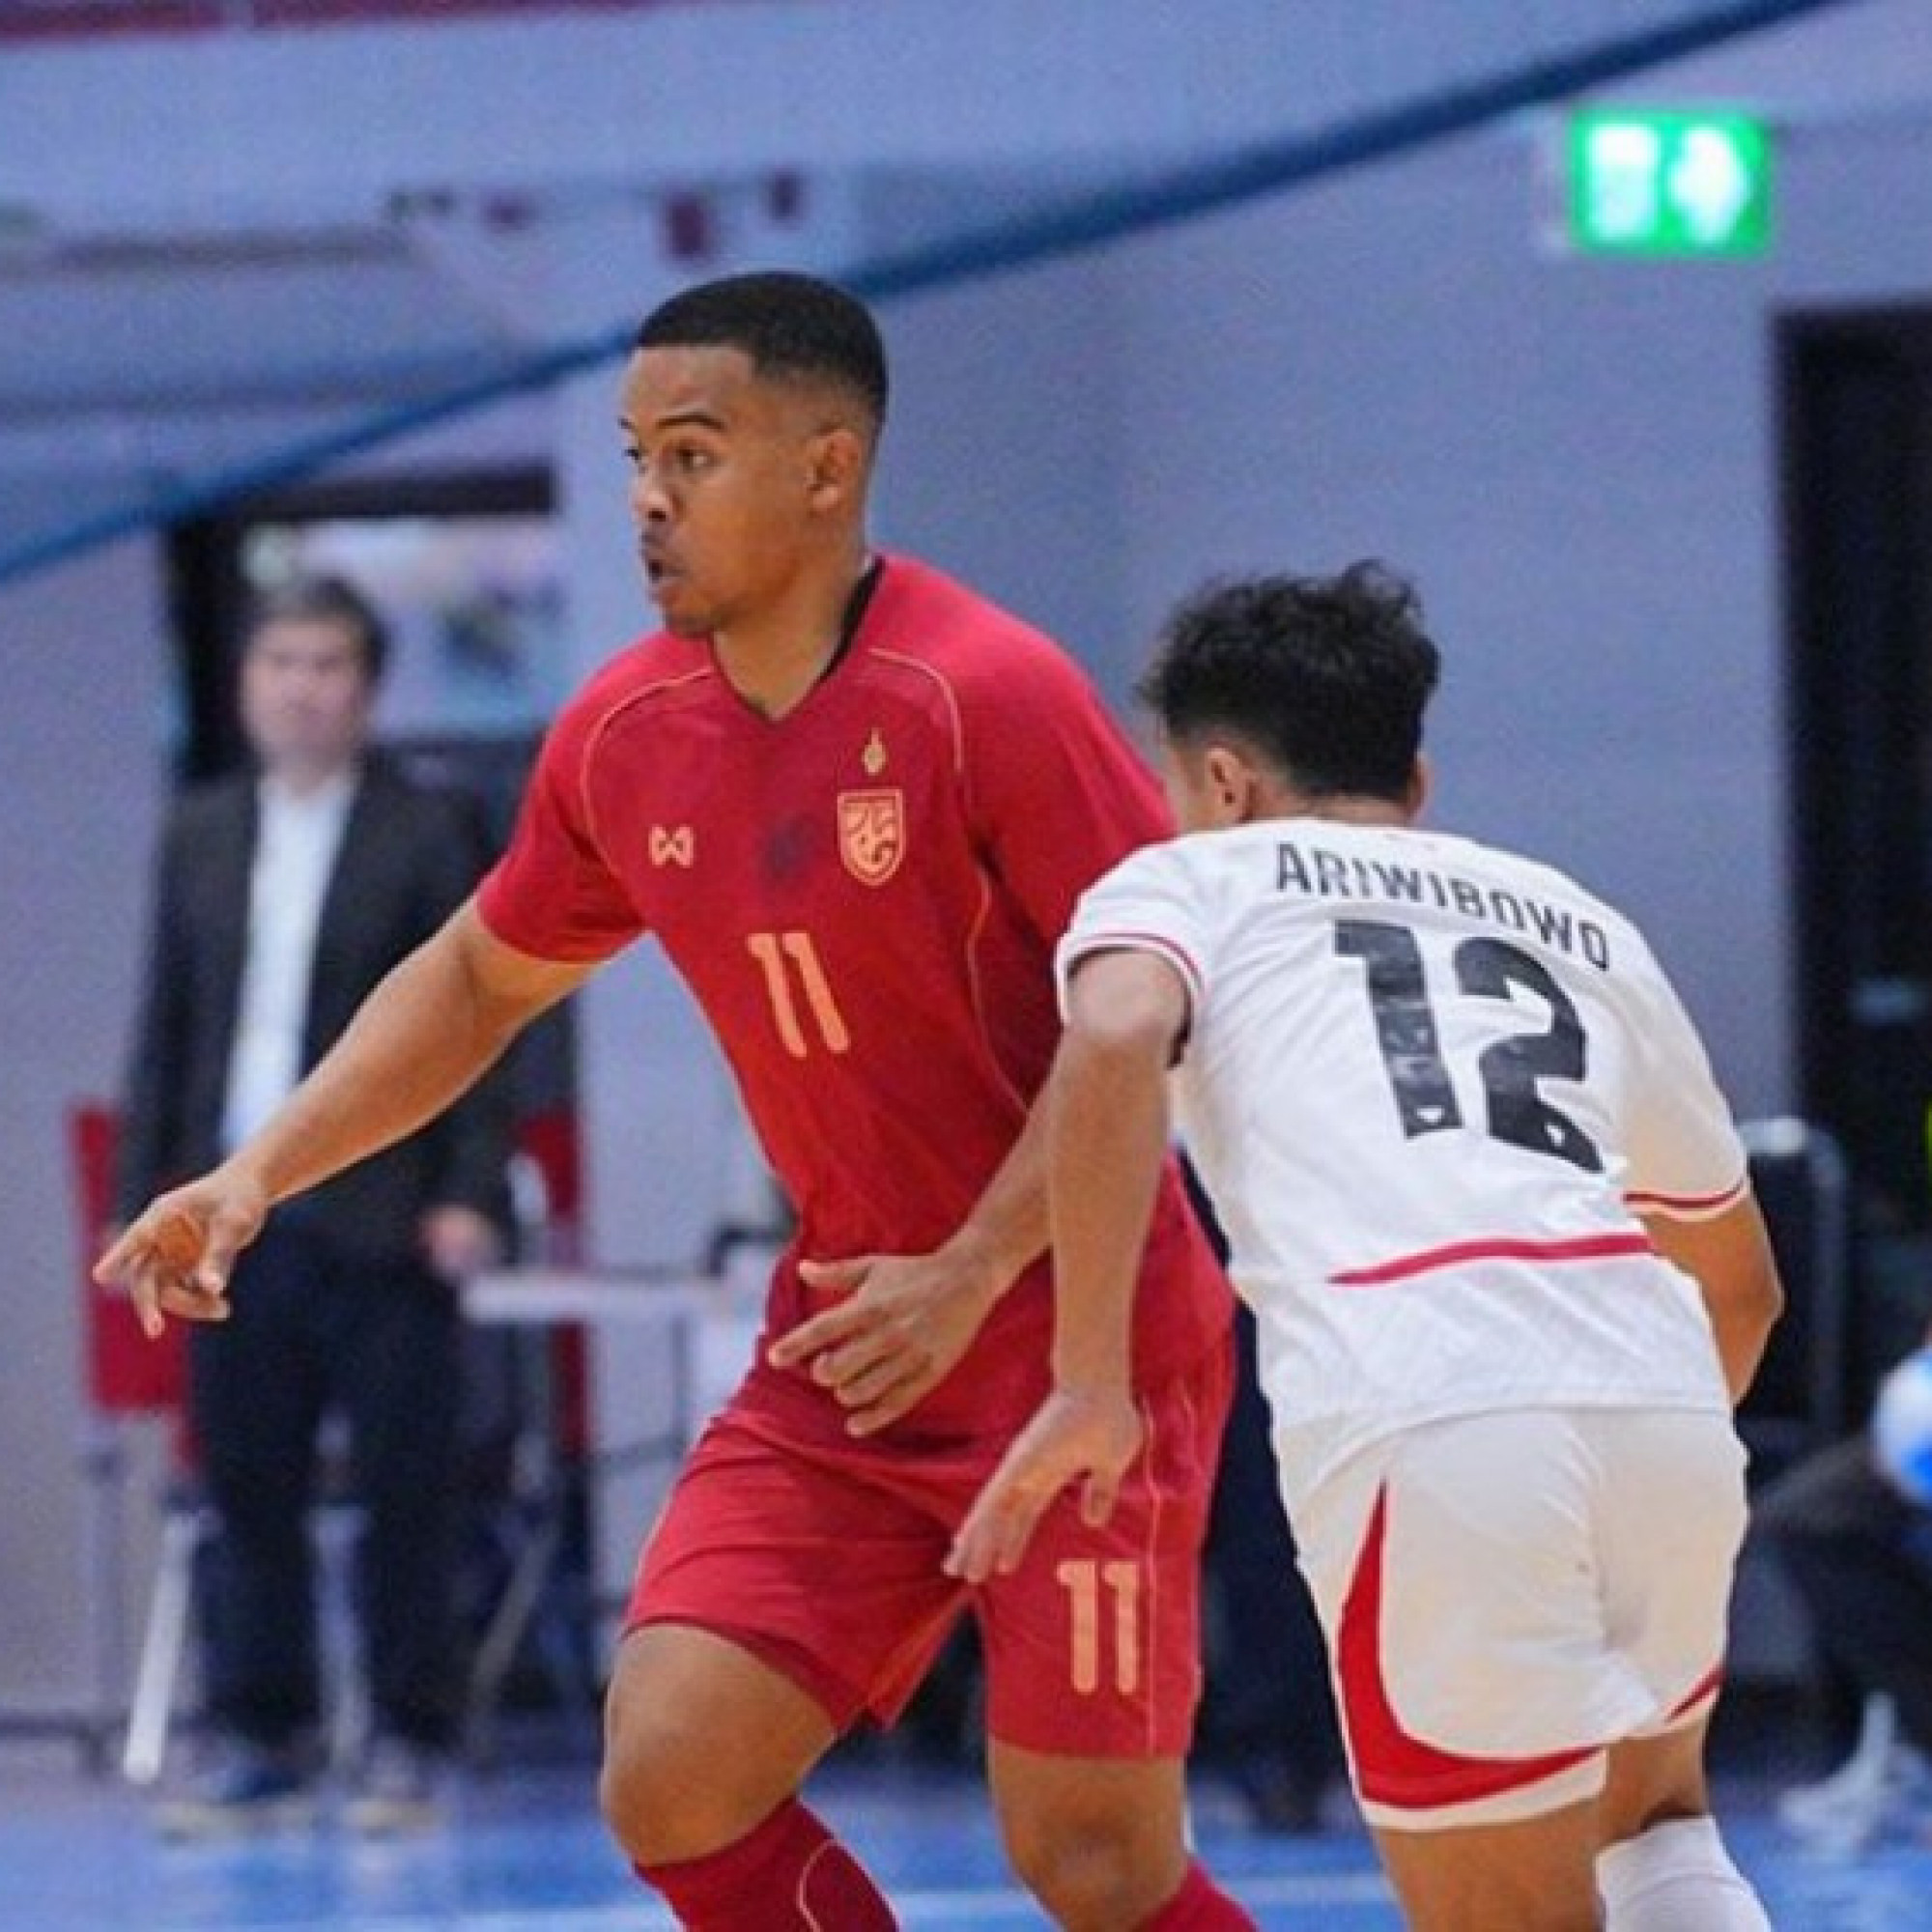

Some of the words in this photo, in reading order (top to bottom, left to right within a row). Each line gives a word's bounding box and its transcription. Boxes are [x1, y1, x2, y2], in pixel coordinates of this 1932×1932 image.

[1276, 841, 1610, 972] ARIWIBOWO
[746, 931, 851, 1058] 11
[1333, 918, 1605, 1175] 12
[1055, 1559, 1140, 1696] 11
